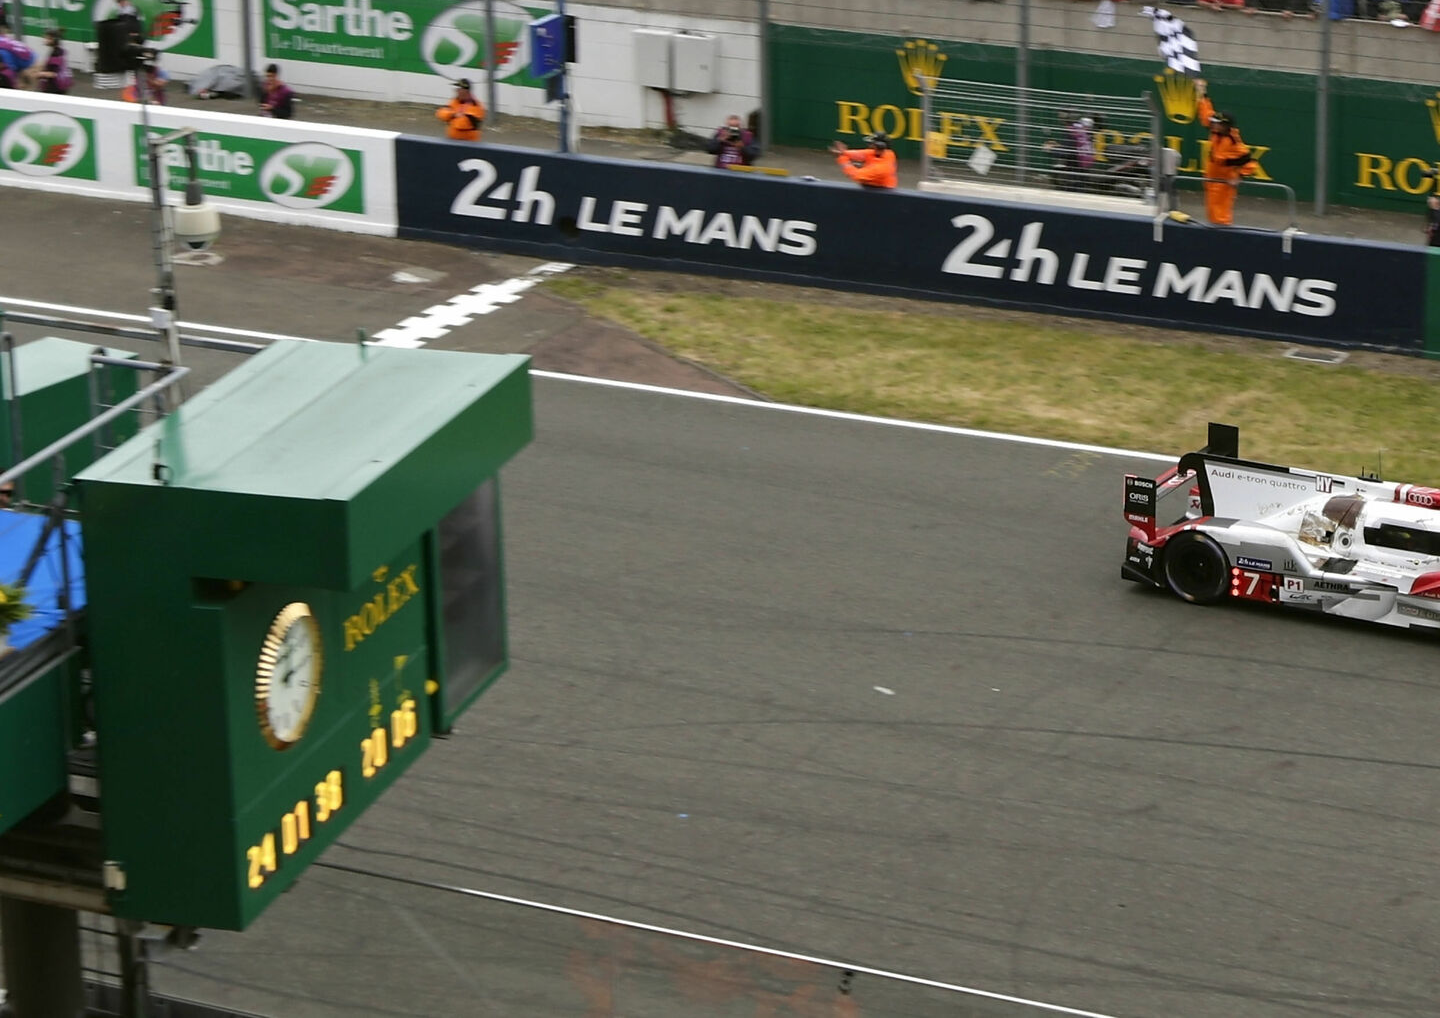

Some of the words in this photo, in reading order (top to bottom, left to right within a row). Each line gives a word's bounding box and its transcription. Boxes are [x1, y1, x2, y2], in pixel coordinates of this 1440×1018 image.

[449, 157, 556, 226] 24h
[575, 196, 649, 238] LE
[652, 204, 818, 257] MANS
[940, 213, 1060, 286] 24h
[1066, 252, 1148, 296] LE
[1152, 261, 1338, 318] MANS
[1210, 468, 1236, 480] Audi
[1237, 473, 1267, 485] e-tron
[1269, 479, 1307, 492] quattro
[1315, 475, 1333, 494] HY
[1129, 492, 1150, 502] ORIS
[1243, 572, 1260, 595] 7
[1287, 579, 1301, 591] P1
[1314, 581, 1350, 591] AETHRA
[342, 564, 420, 651] ROLEX
[360, 727, 388, 778] 20
[246, 832, 277, 888] 24
[281, 800, 311, 854] 01
